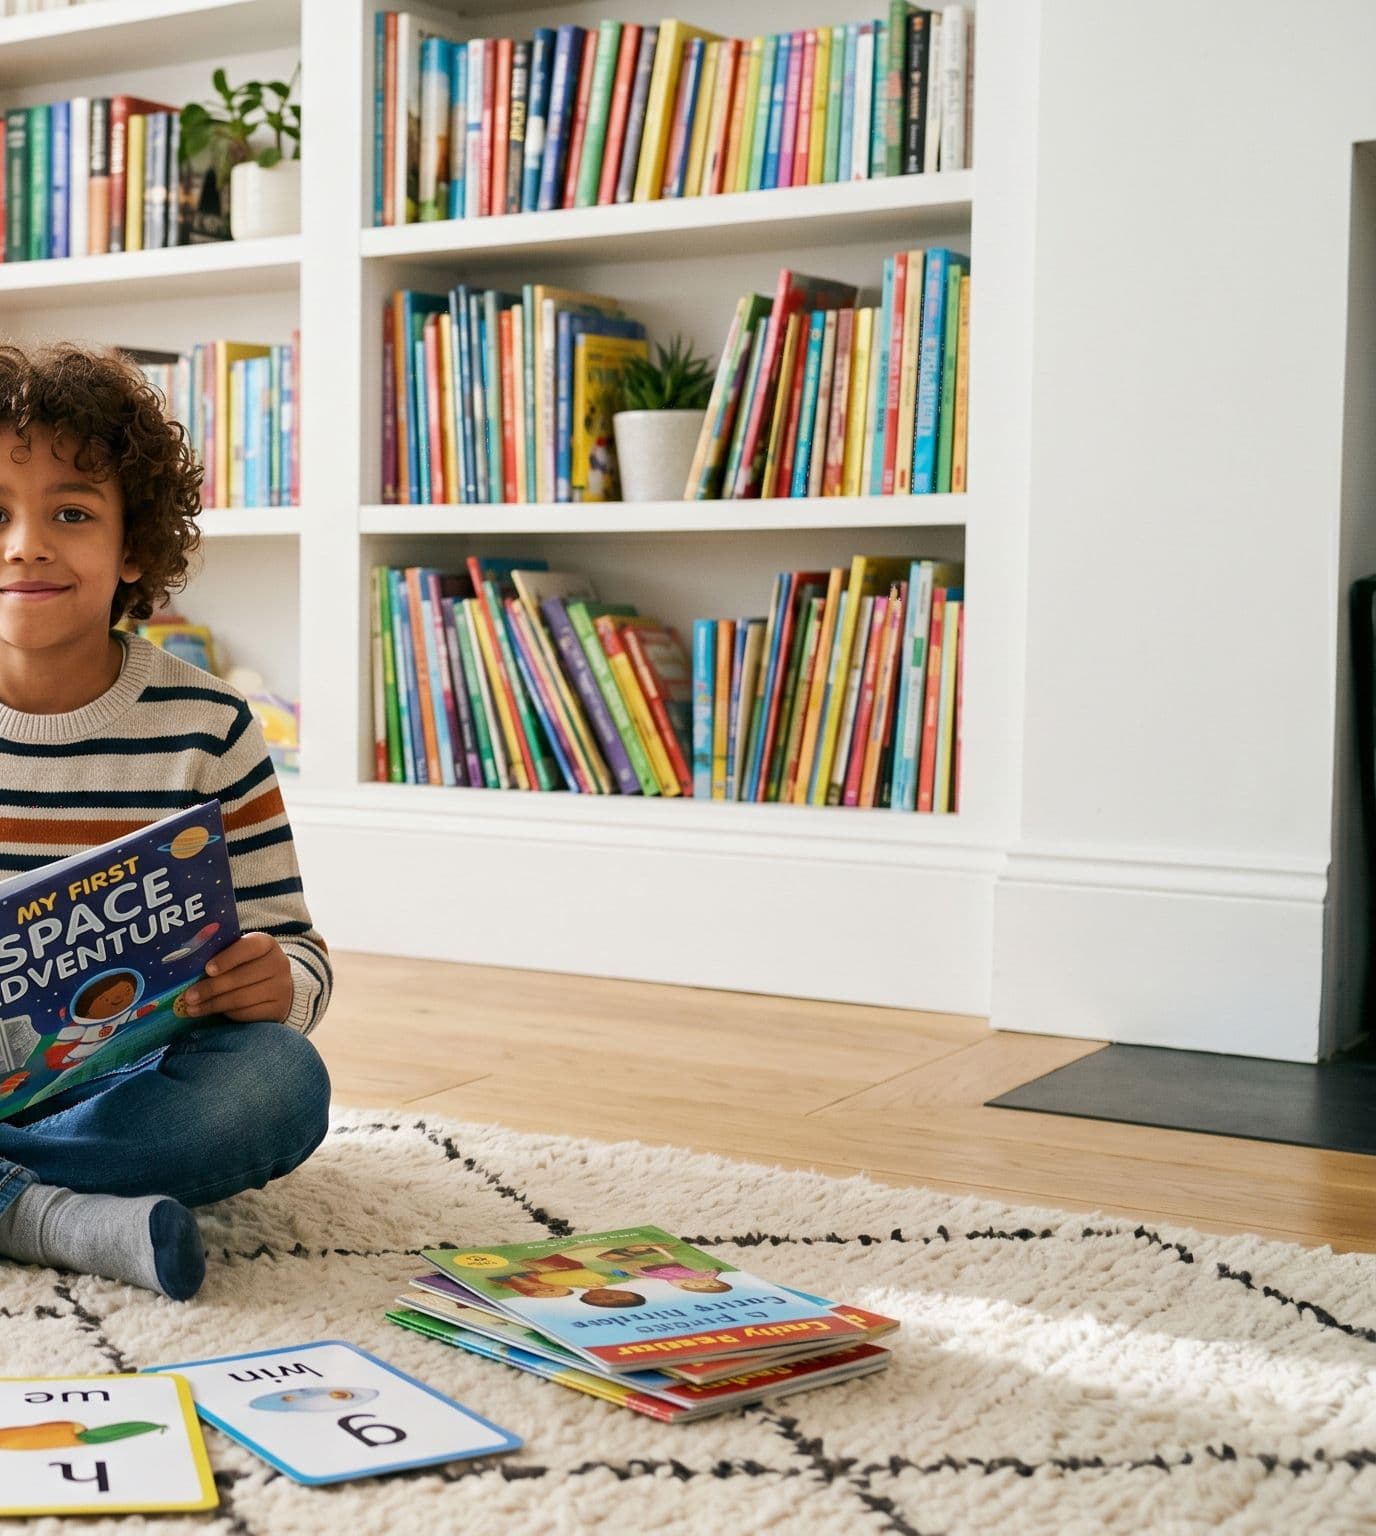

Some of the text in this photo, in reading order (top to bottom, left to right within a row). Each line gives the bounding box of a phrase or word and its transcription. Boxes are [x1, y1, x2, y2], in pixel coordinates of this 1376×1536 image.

[17, 856, 139, 925] MY FIRST
[24, 1390, 110, 1404] we
